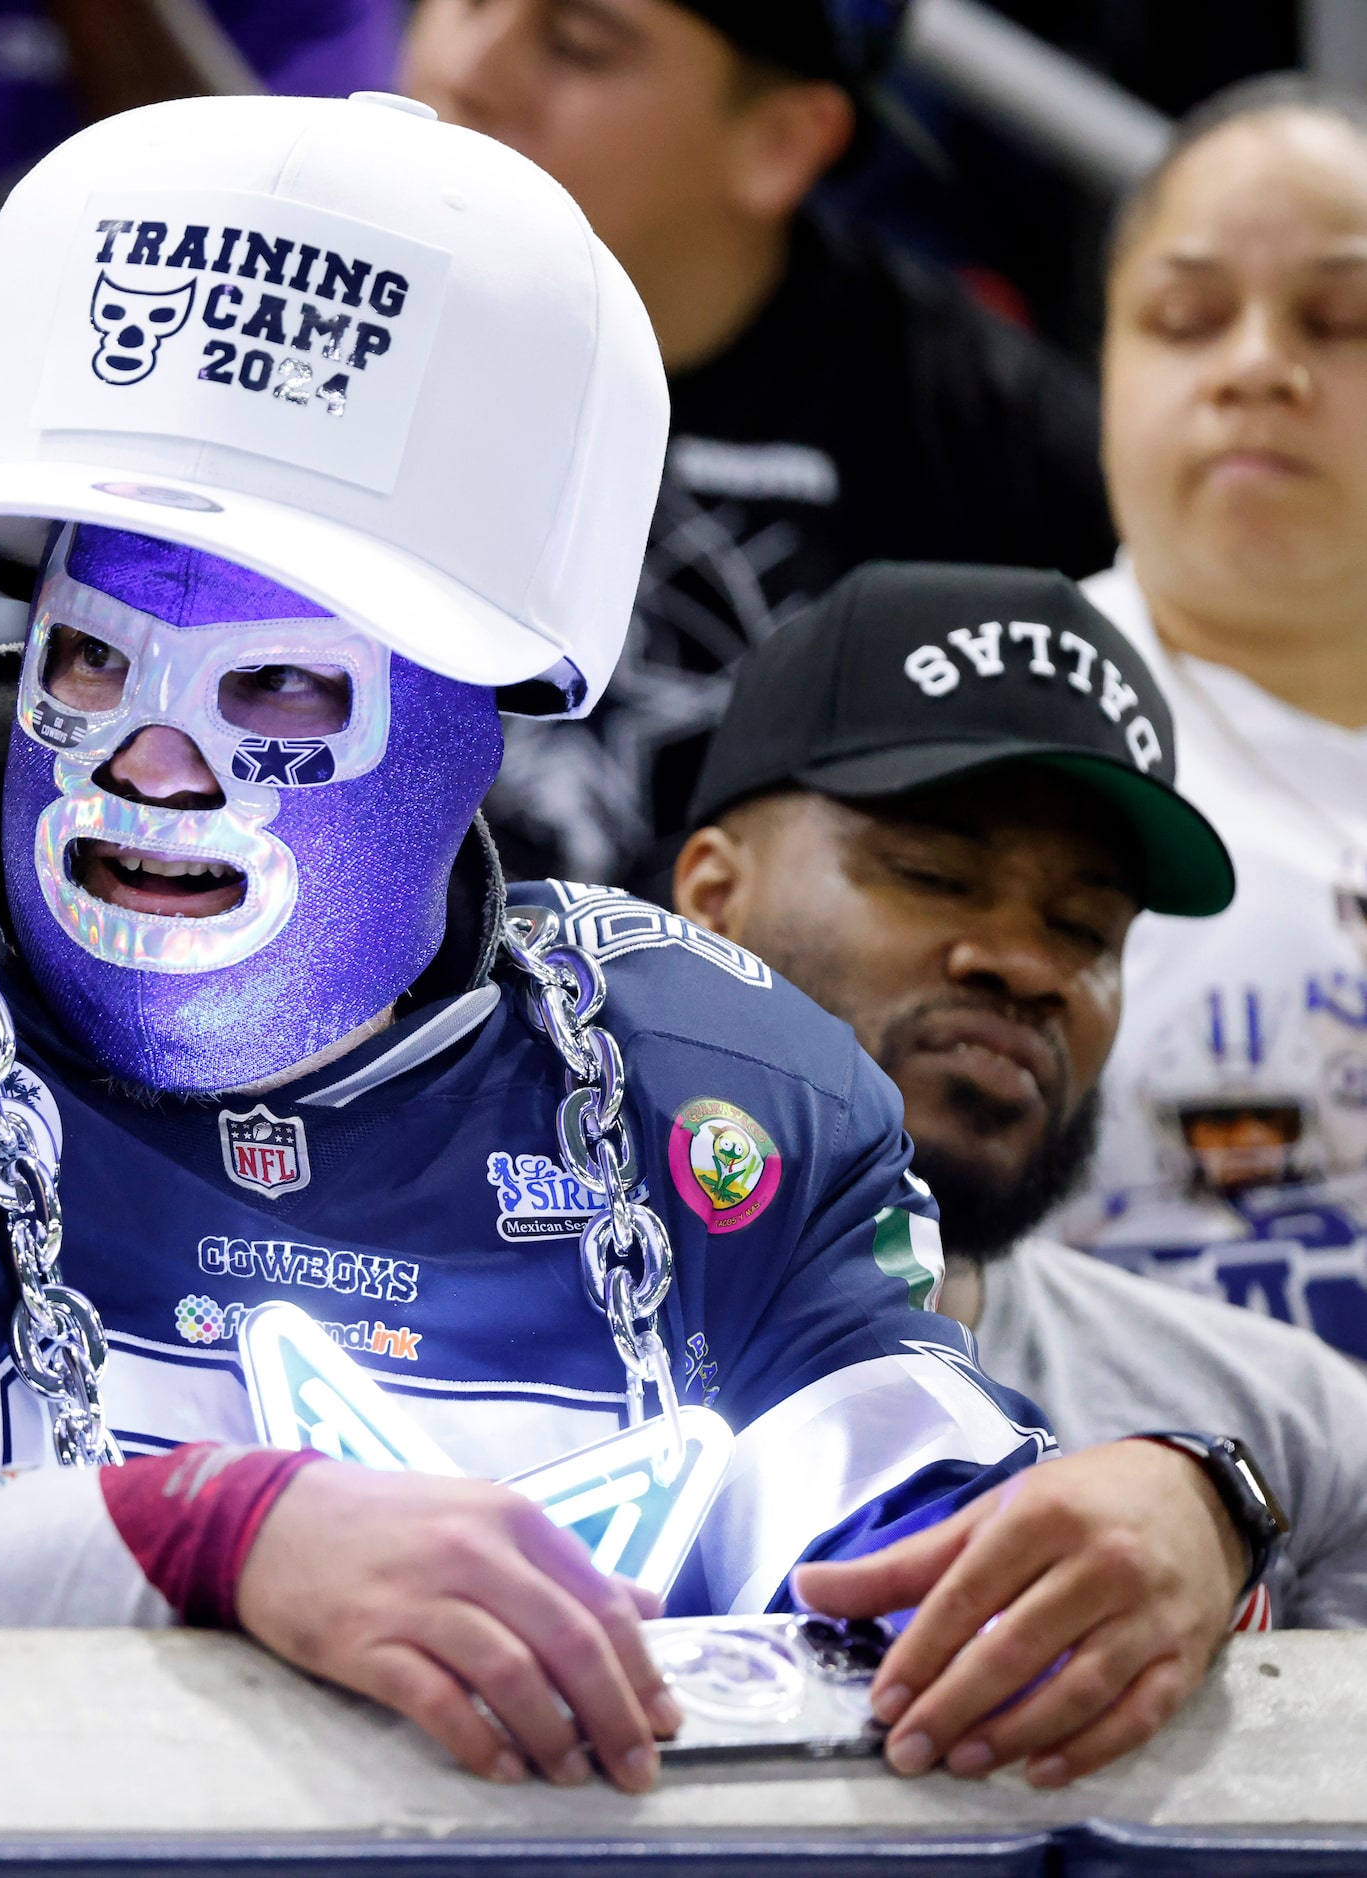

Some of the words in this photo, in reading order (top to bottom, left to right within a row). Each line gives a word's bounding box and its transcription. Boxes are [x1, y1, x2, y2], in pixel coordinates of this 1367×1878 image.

[95, 219, 409, 317] TRAINING
[202, 283, 391, 370] CAMP
[198, 339, 350, 418] 2024
[54, 716, 64, 729] GO
[904, 620, 1162, 774] DALLAS
[236, 1146, 295, 1183] NFL
[521, 1159, 558, 1180] La
[506, 1220, 564, 1234] Mexican
[715, 1217, 737, 1228] TACOS
[198, 1236, 419, 1303] COWBOYS
